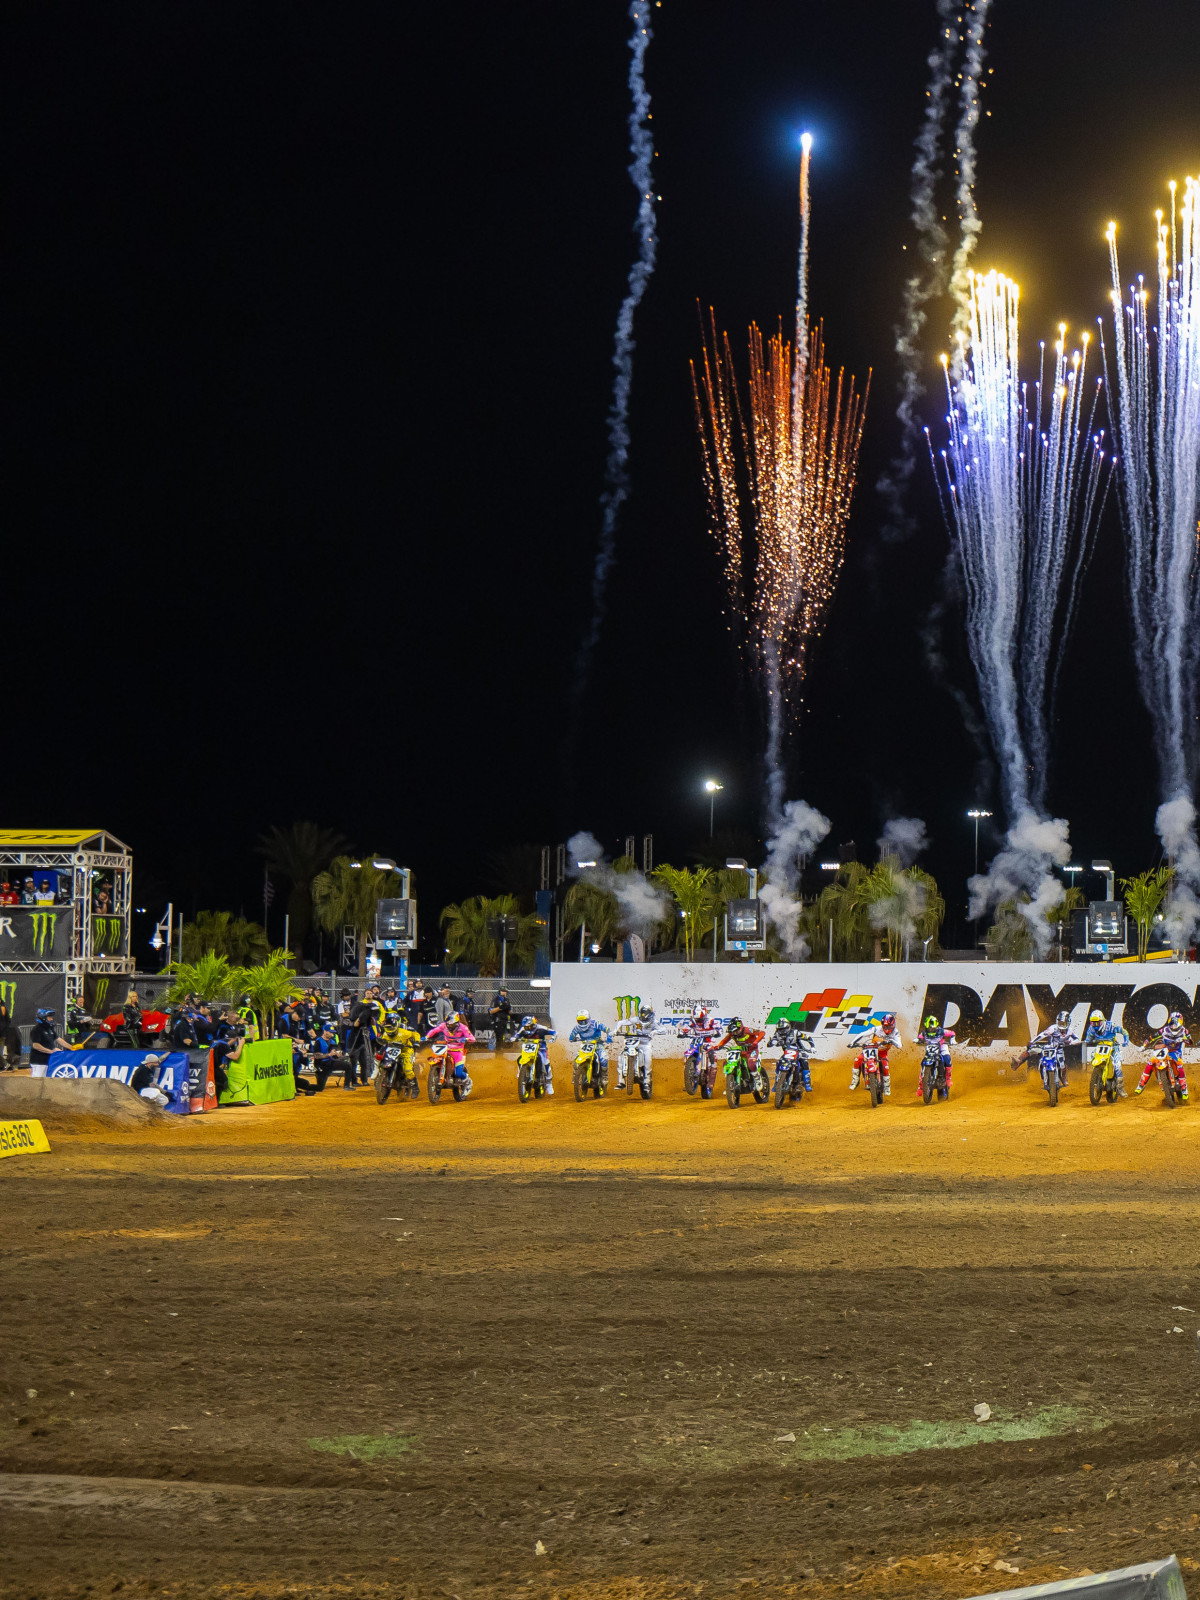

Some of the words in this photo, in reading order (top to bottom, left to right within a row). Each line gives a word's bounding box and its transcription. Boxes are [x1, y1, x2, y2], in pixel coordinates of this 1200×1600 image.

[434, 1045, 446, 1056] 7
[525, 1043, 536, 1052] 94
[581, 1043, 594, 1052] 45
[728, 1052, 740, 1060] 21
[785, 1050, 796, 1060] 2
[864, 1049, 876, 1058] 14
[1156, 1050, 1165, 1058] 4
[253, 1060, 289, 1081] Kawasaki
[82, 1066, 174, 1091] YAMA
[0, 1124, 35, 1150] sta360
